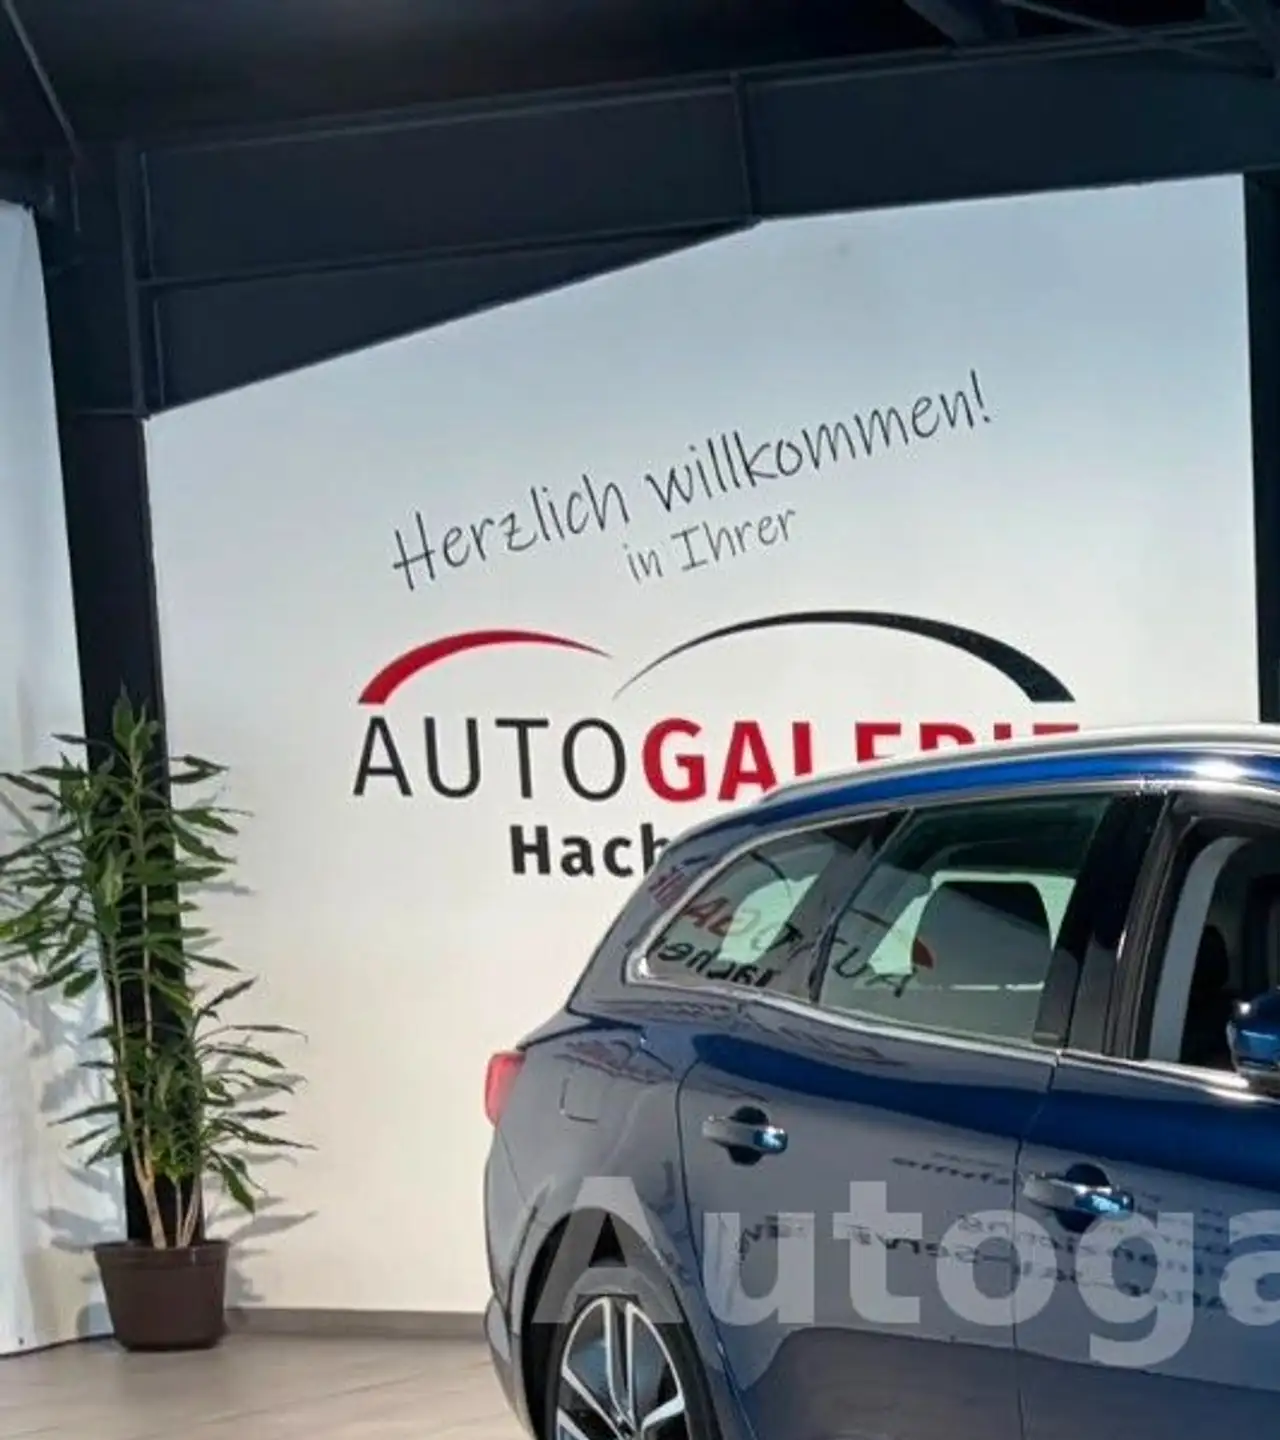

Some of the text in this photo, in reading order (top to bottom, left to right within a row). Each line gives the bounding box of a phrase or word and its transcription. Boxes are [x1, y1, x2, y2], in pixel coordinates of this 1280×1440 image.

[392, 369, 994, 591] Herzlich willkommen!
[623, 506, 799, 585] in Ihrer
[353, 716, 1080, 804] AUTOGALE
